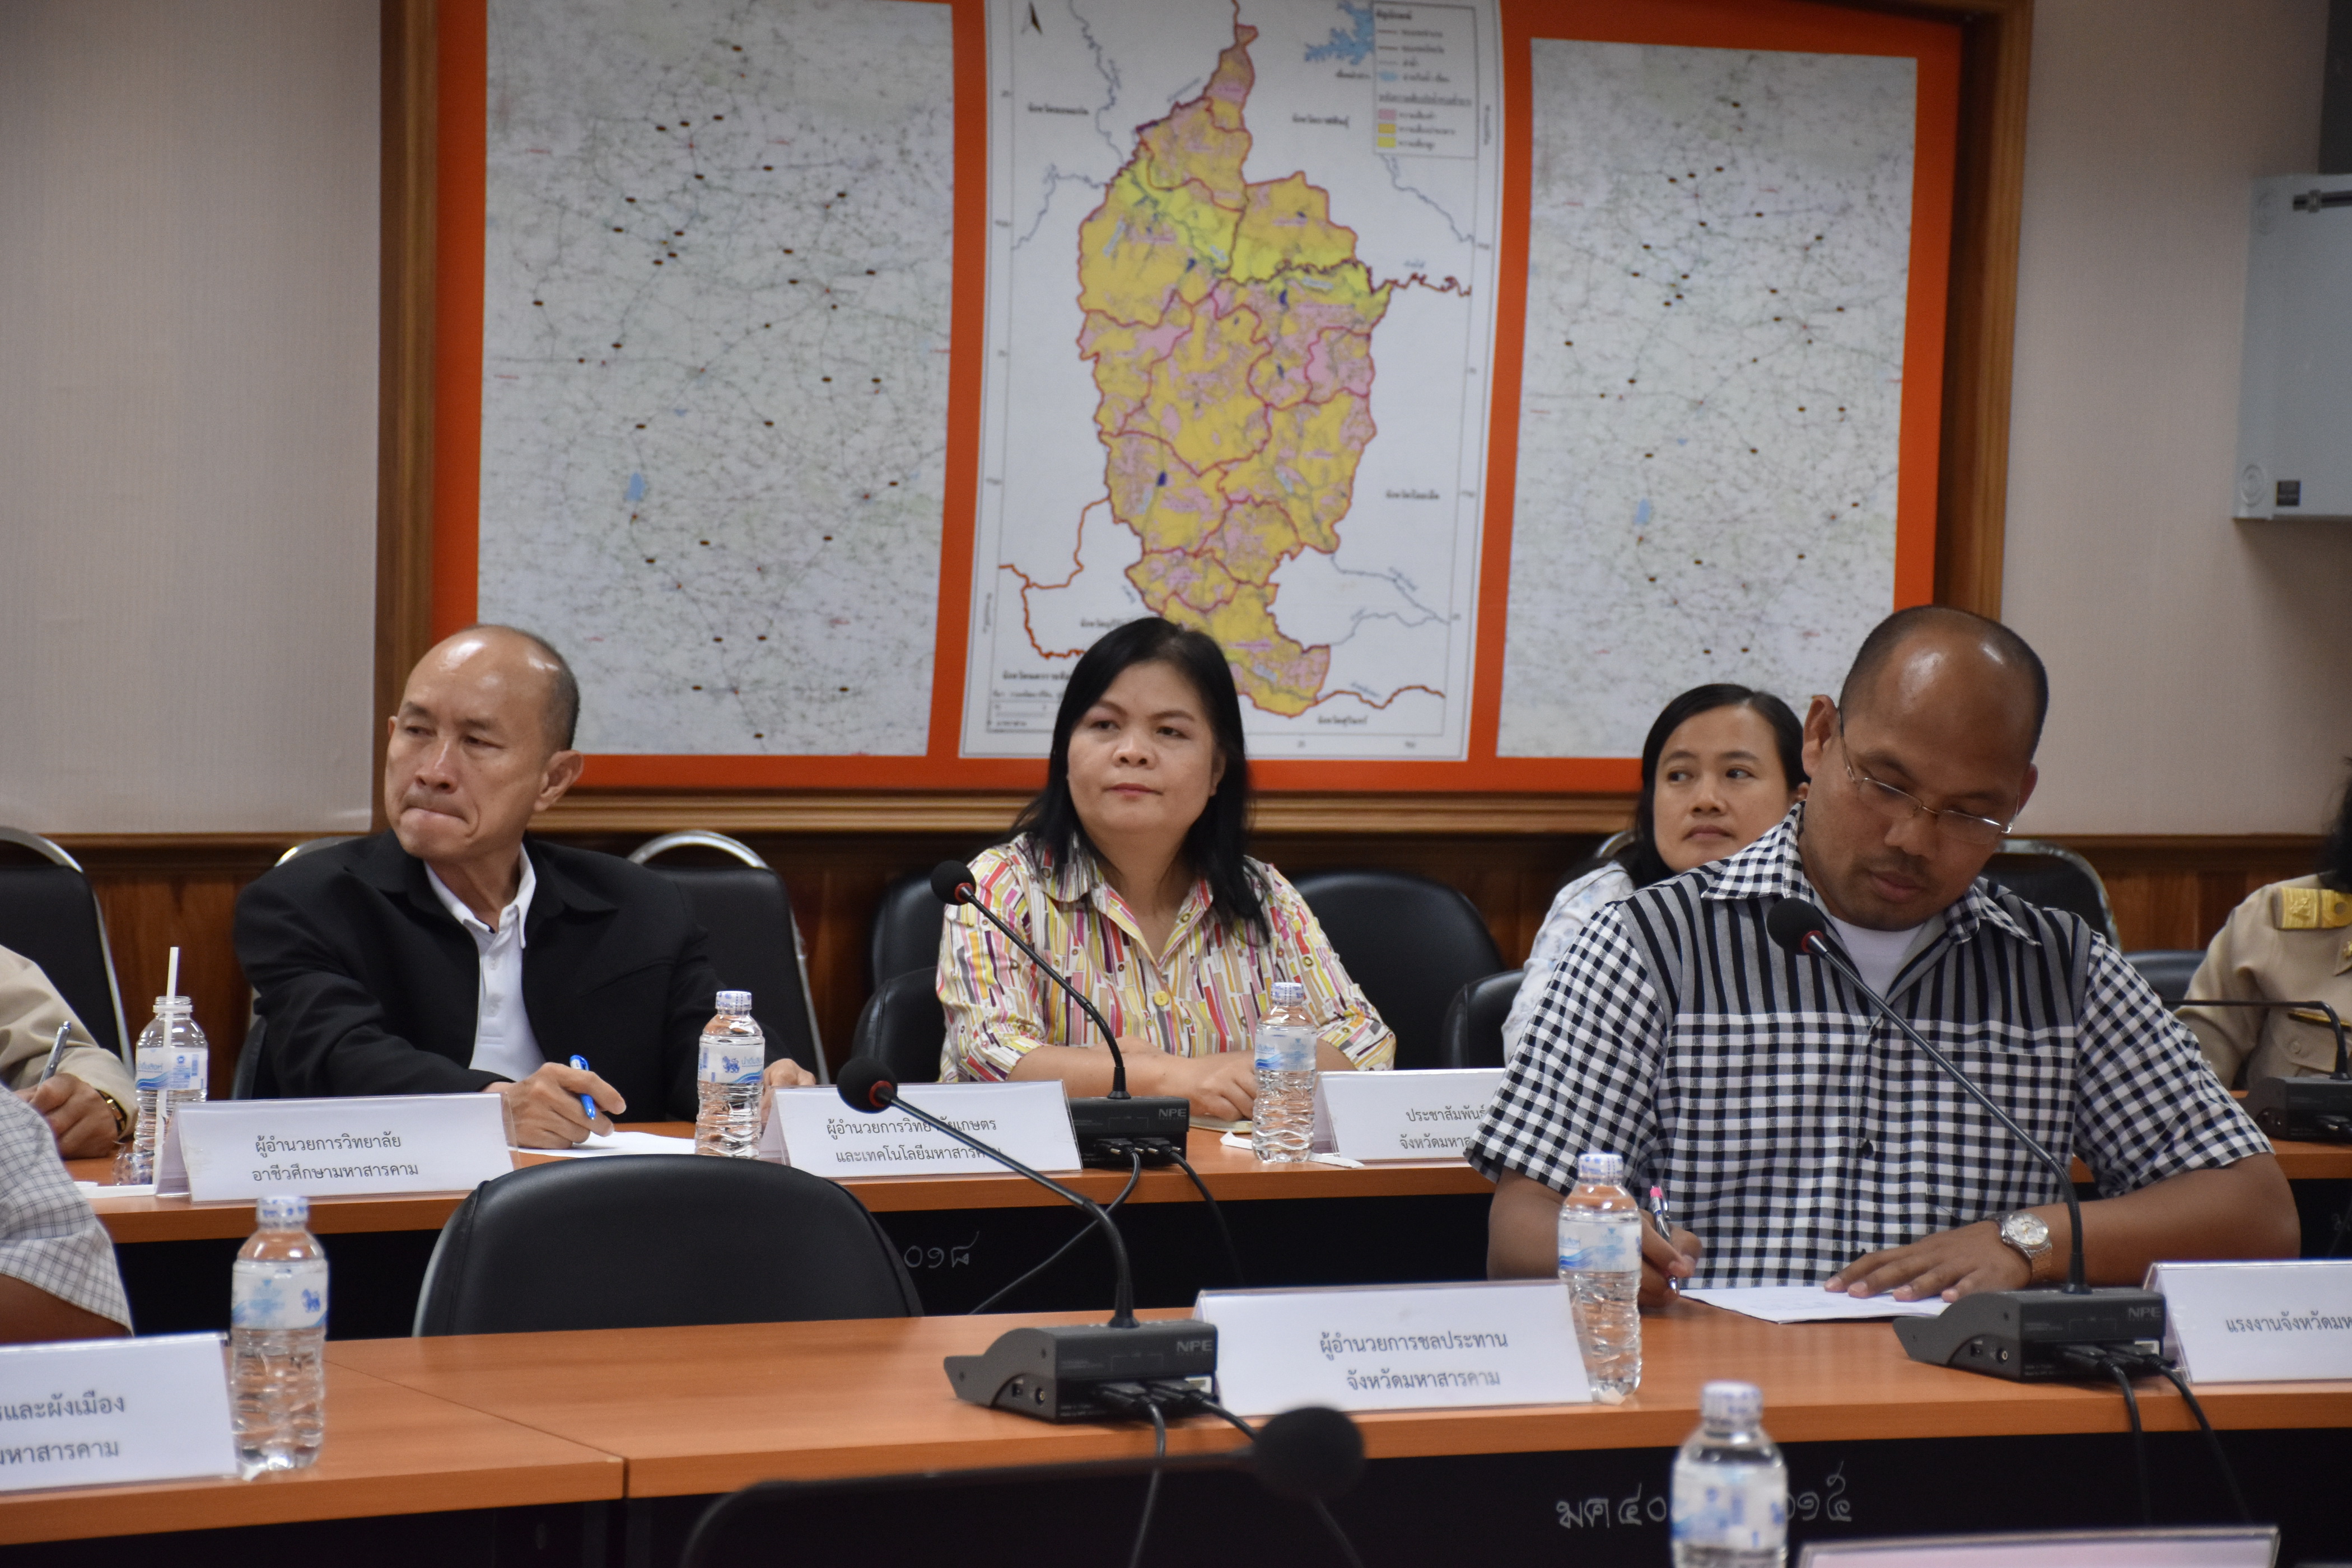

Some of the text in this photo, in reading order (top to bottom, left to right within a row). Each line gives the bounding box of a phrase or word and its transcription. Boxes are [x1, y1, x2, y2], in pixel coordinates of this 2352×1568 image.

[1159, 1109, 1187, 1117] NPE
[255, 1131, 402, 1158] ผู้อำนวยการวิทยาลัย
[251, 1163, 419, 1182] อาชีวศึกษามหาสารคาม
[2128, 1306, 2162, 1318] NPE
[1177, 1340, 1214, 1352] NPE
[1320, 1331, 1509, 1361] ผู้อำนวยการชลประทาน
[1346, 1368, 1501, 1391] จังหวัดมหาสารคาม
[0, 1390, 125, 1421] และผังเมือง
